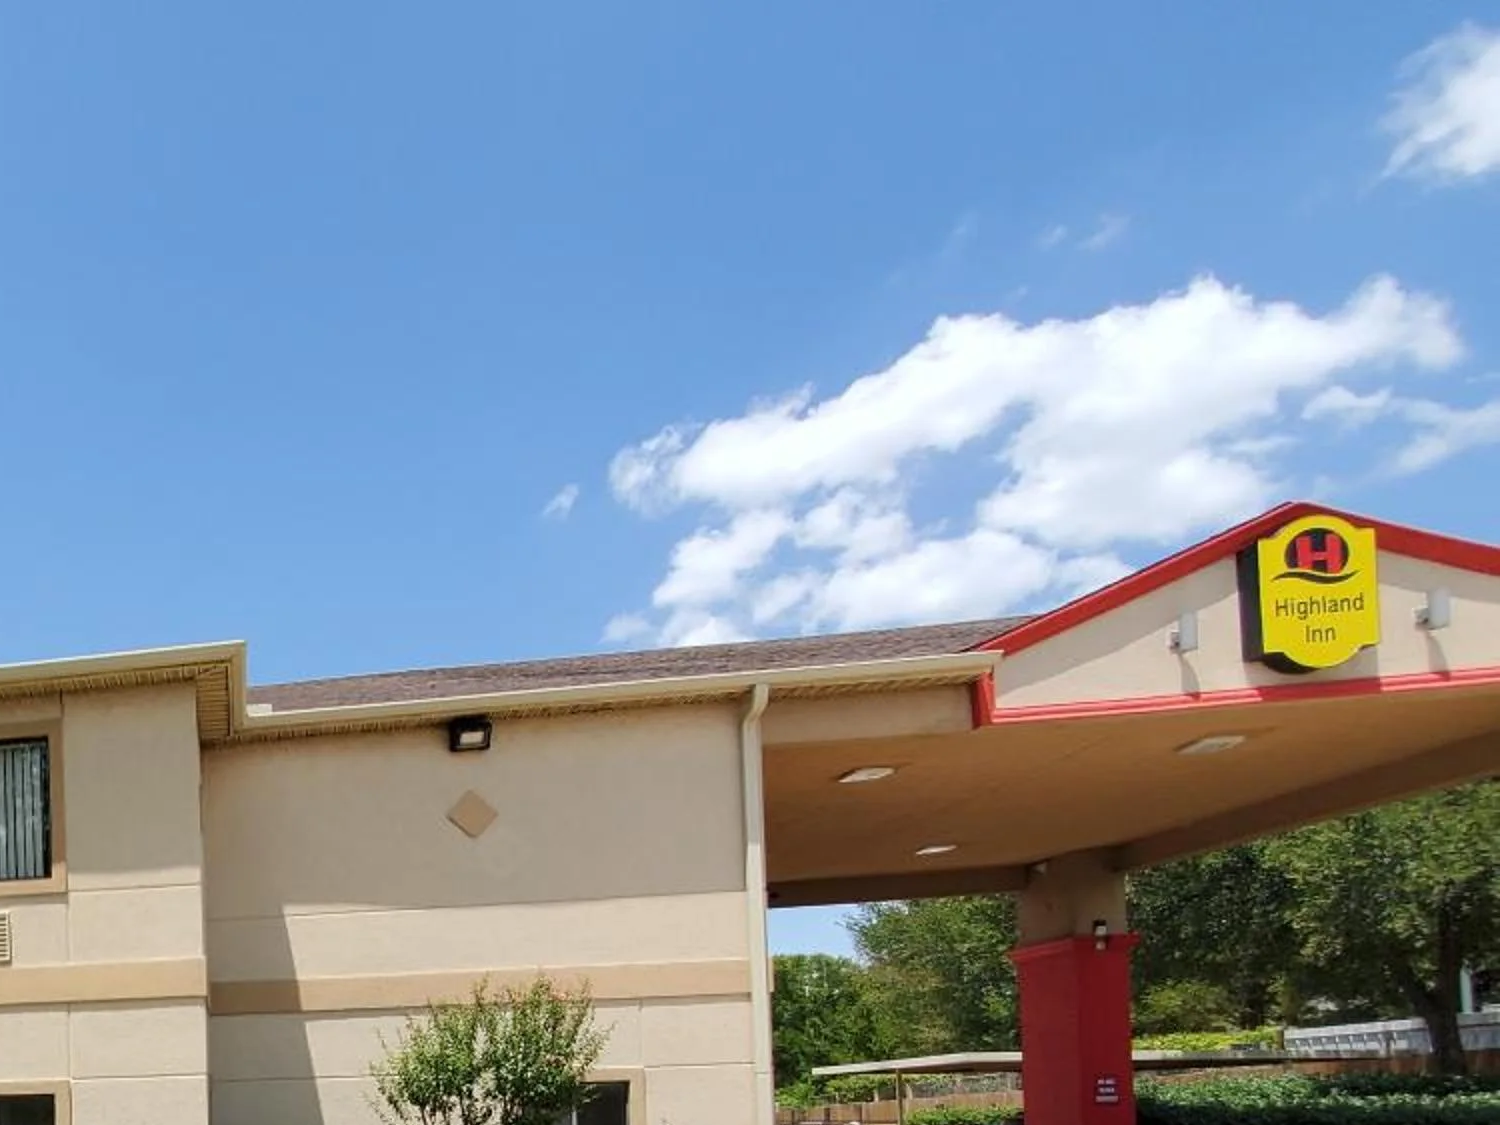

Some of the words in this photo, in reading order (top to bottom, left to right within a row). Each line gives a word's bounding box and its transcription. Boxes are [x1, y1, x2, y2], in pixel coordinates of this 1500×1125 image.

[1297, 535, 1342, 574] H
[1275, 592, 1364, 620] Highland
[1305, 625, 1336, 642] Inn
